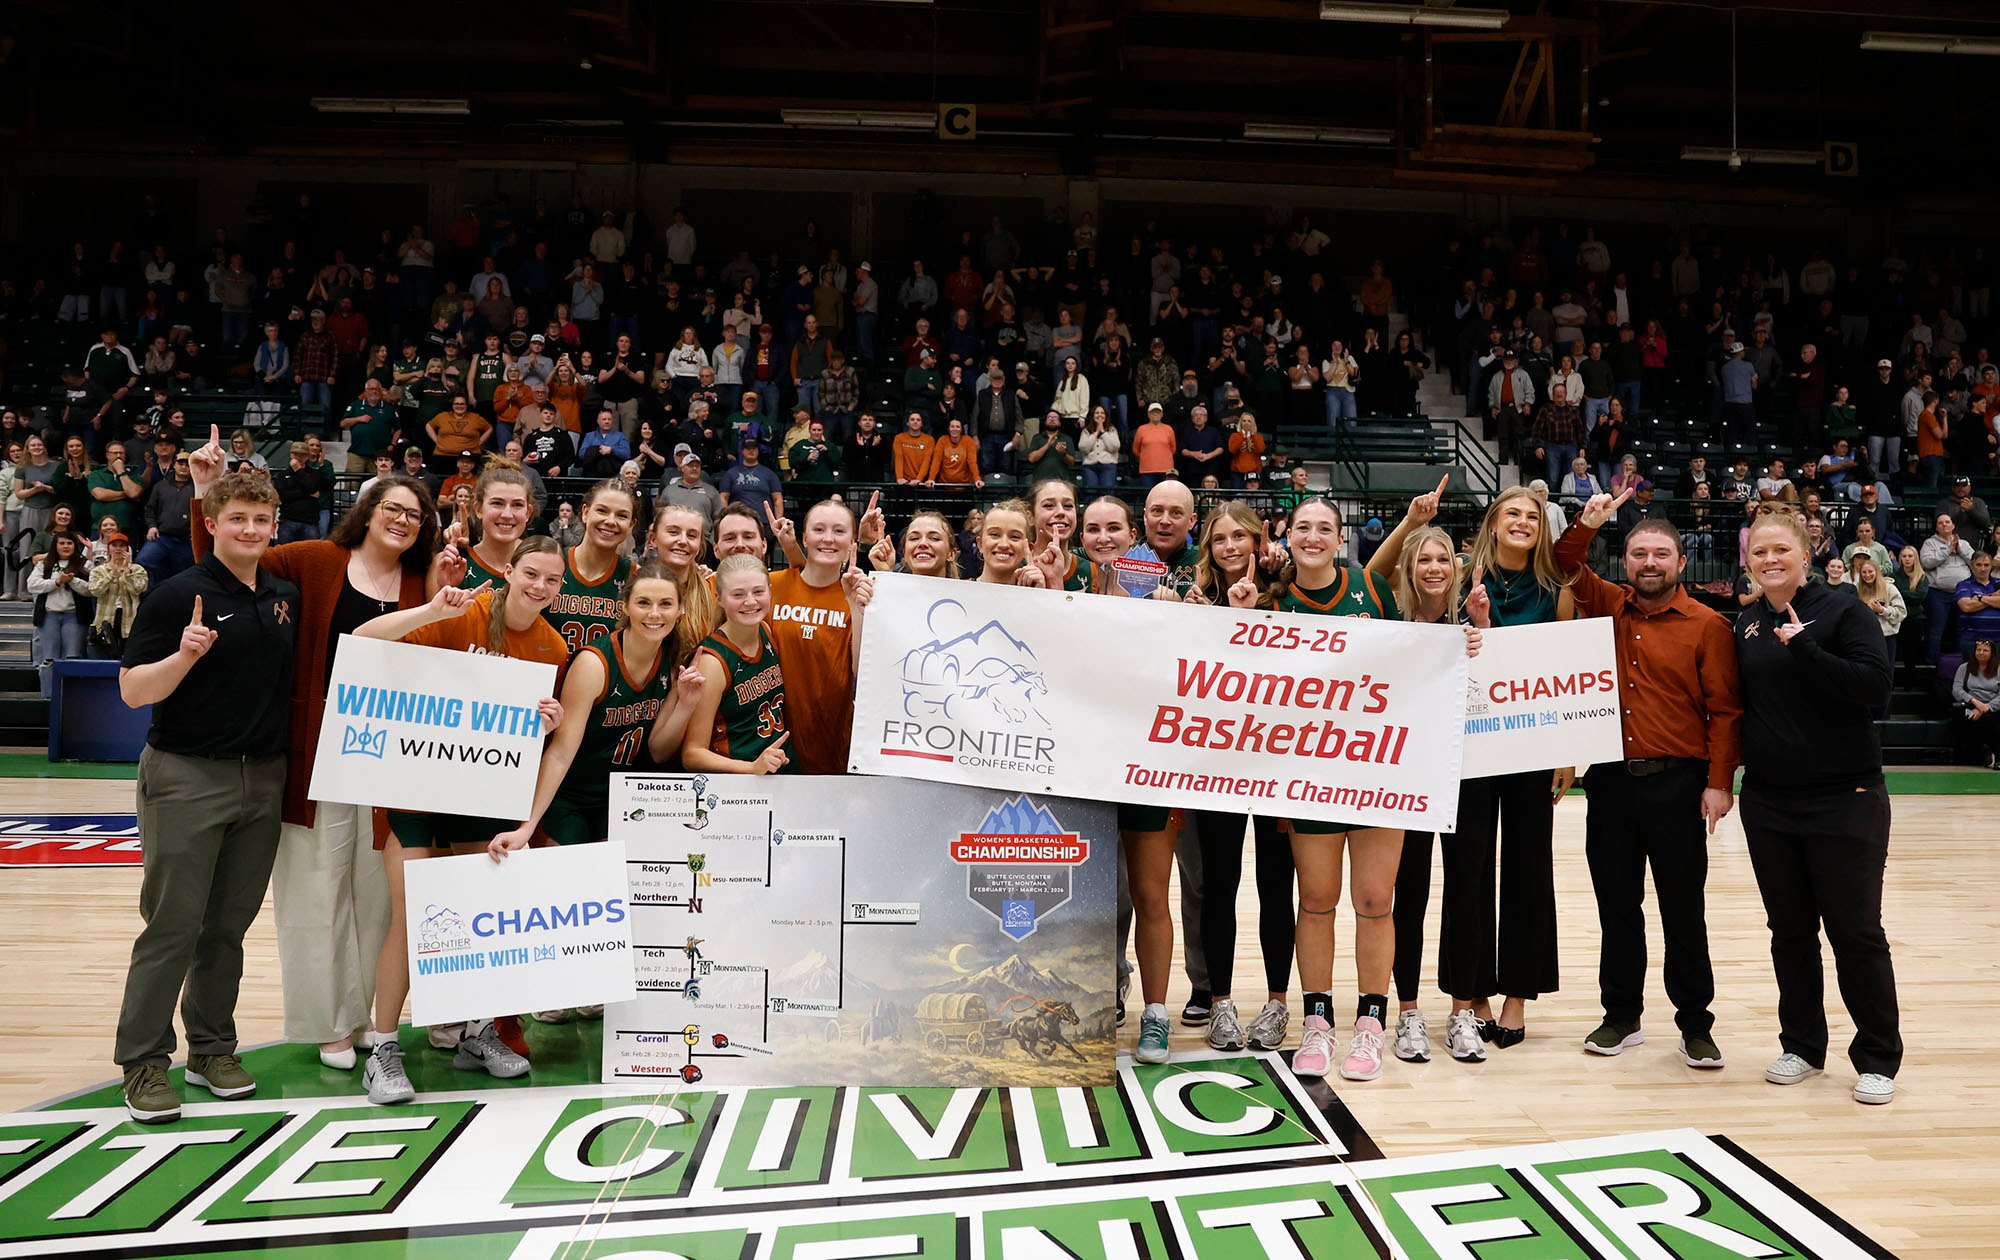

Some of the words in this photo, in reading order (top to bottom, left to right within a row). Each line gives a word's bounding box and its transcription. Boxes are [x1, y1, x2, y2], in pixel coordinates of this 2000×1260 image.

[944, 107, 971, 134] C
[1830, 146, 1853, 170] D
[1115, 562, 1165, 574] CHAMPIONSHIP
[773, 604, 812, 621] LOCK
[812, 608, 829, 625] IT
[828, 610, 847, 628] IN.
[1229, 622, 1348, 654] 2025-26
[1175, 658, 1390, 714] Women's
[1489, 670, 1614, 703] CHAMPS
[337, 683, 463, 728] WINNING
[471, 701, 542, 738] WITH
[602, 698, 665, 727] DIGGER
[1503, 713, 1536, 730] WITH
[1562, 707, 1615, 721] WINWON
[612, 727, 644, 765] 11
[882, 720, 1056, 762] FRONTIER
[1148, 705, 1409, 765] Basketball
[400, 738, 522, 768] WINWON
[958, 755, 1056, 775] CONFERENCE
[637, 783, 671, 791] Dakota
[673, 783, 686, 791] St.
[1124, 763, 1277, 798] Tournament
[1285, 780, 1429, 813] Champions
[973, 836, 1011, 844] WOMEN'S
[957, 845, 1080, 860] CHAMPIONSHIP
[642, 865, 671, 874] Rocky
[633, 893, 678, 902] Northern
[688, 898, 703, 913] N
[472, 898, 626, 937] CHAMPS
[417, 938, 471, 951] FRONTIER
[417, 953, 485, 975] WINNING
[489, 947, 529, 967] WITH
[562, 940, 626, 956] WINWON
[636, 1035, 669, 1043] Carroll
[730, 1042, 752, 1050] Montana
[752, 1047, 773, 1055] Western
[631, 1064, 672, 1073] Western
[543, 1071, 1285, 1182] CIVIC
